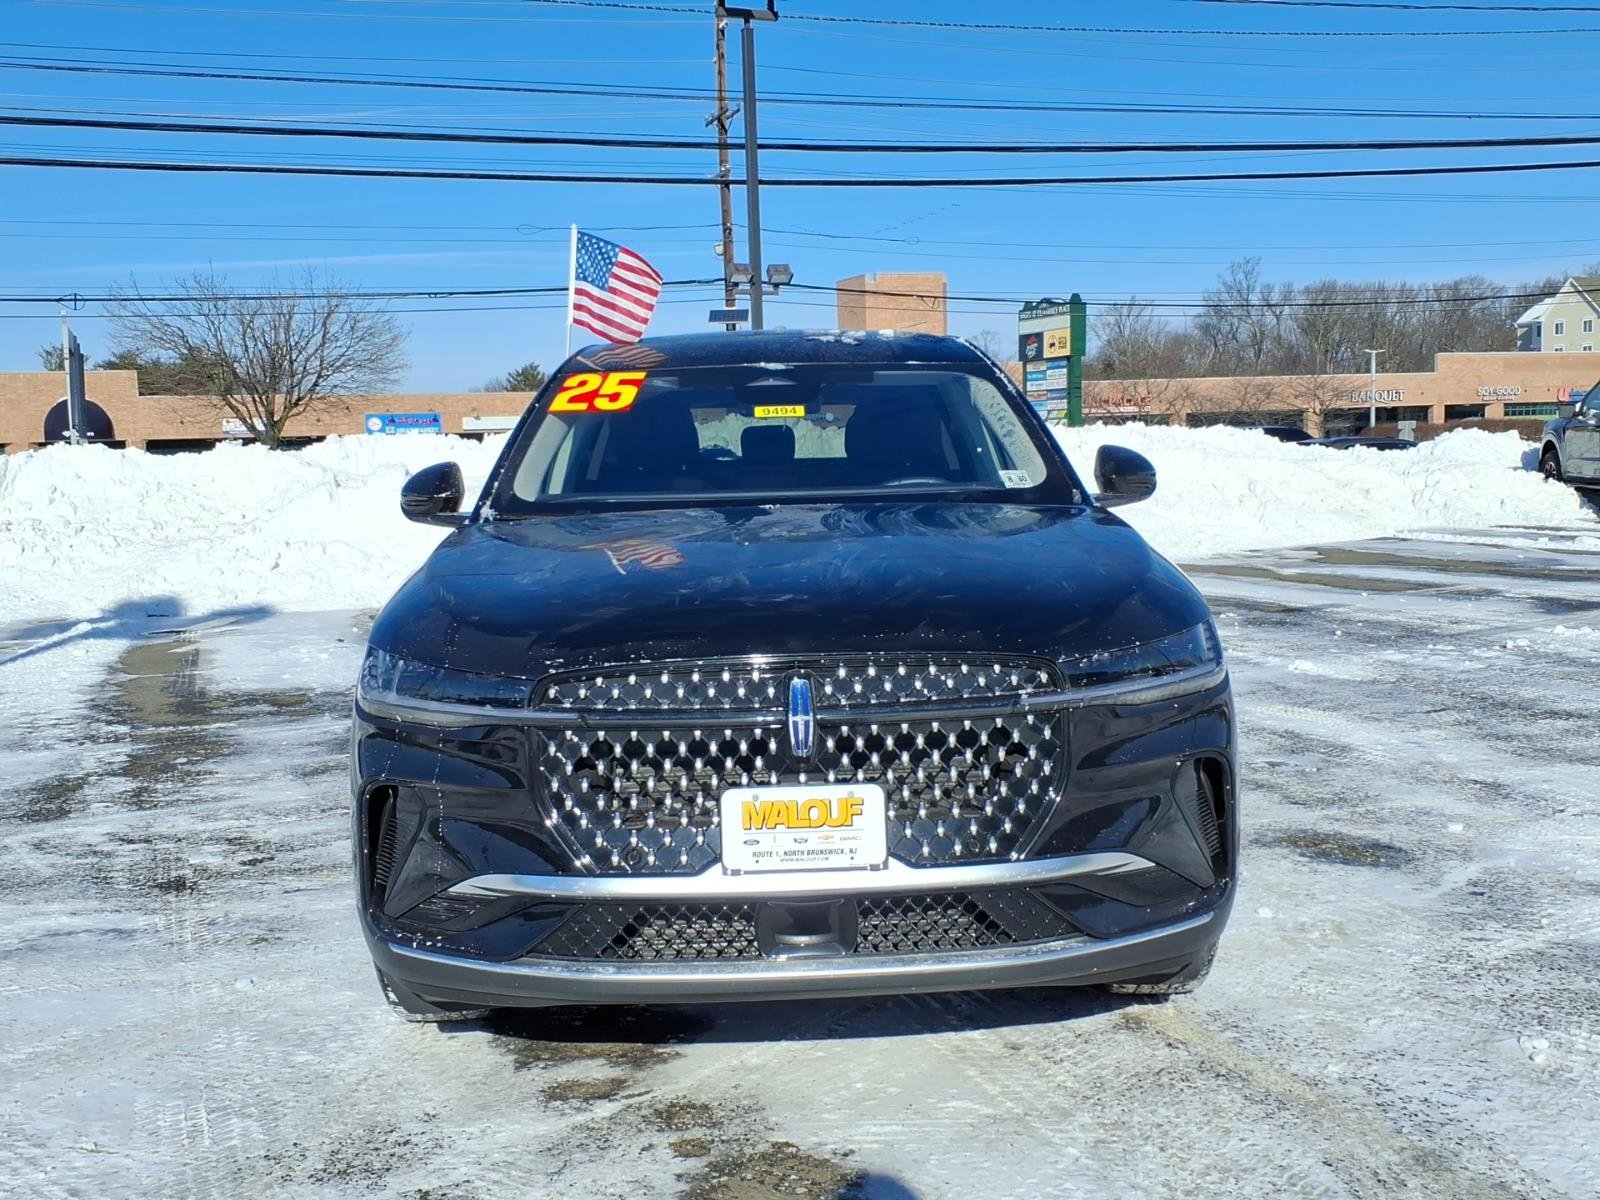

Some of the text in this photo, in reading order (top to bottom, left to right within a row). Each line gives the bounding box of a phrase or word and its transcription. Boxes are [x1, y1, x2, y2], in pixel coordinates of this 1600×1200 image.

[547, 371, 648, 412] 25
[1477, 385, 1521, 396] SOY GOOD
[762, 407, 797, 416] 9494
[742, 797, 864, 831] MALOUF
[752, 851, 773, 859] ROUTE
[783, 849, 805, 857] NORTH
[807, 847, 847, 856] BRUNSWICK,
[849, 847, 858, 855] NJ
